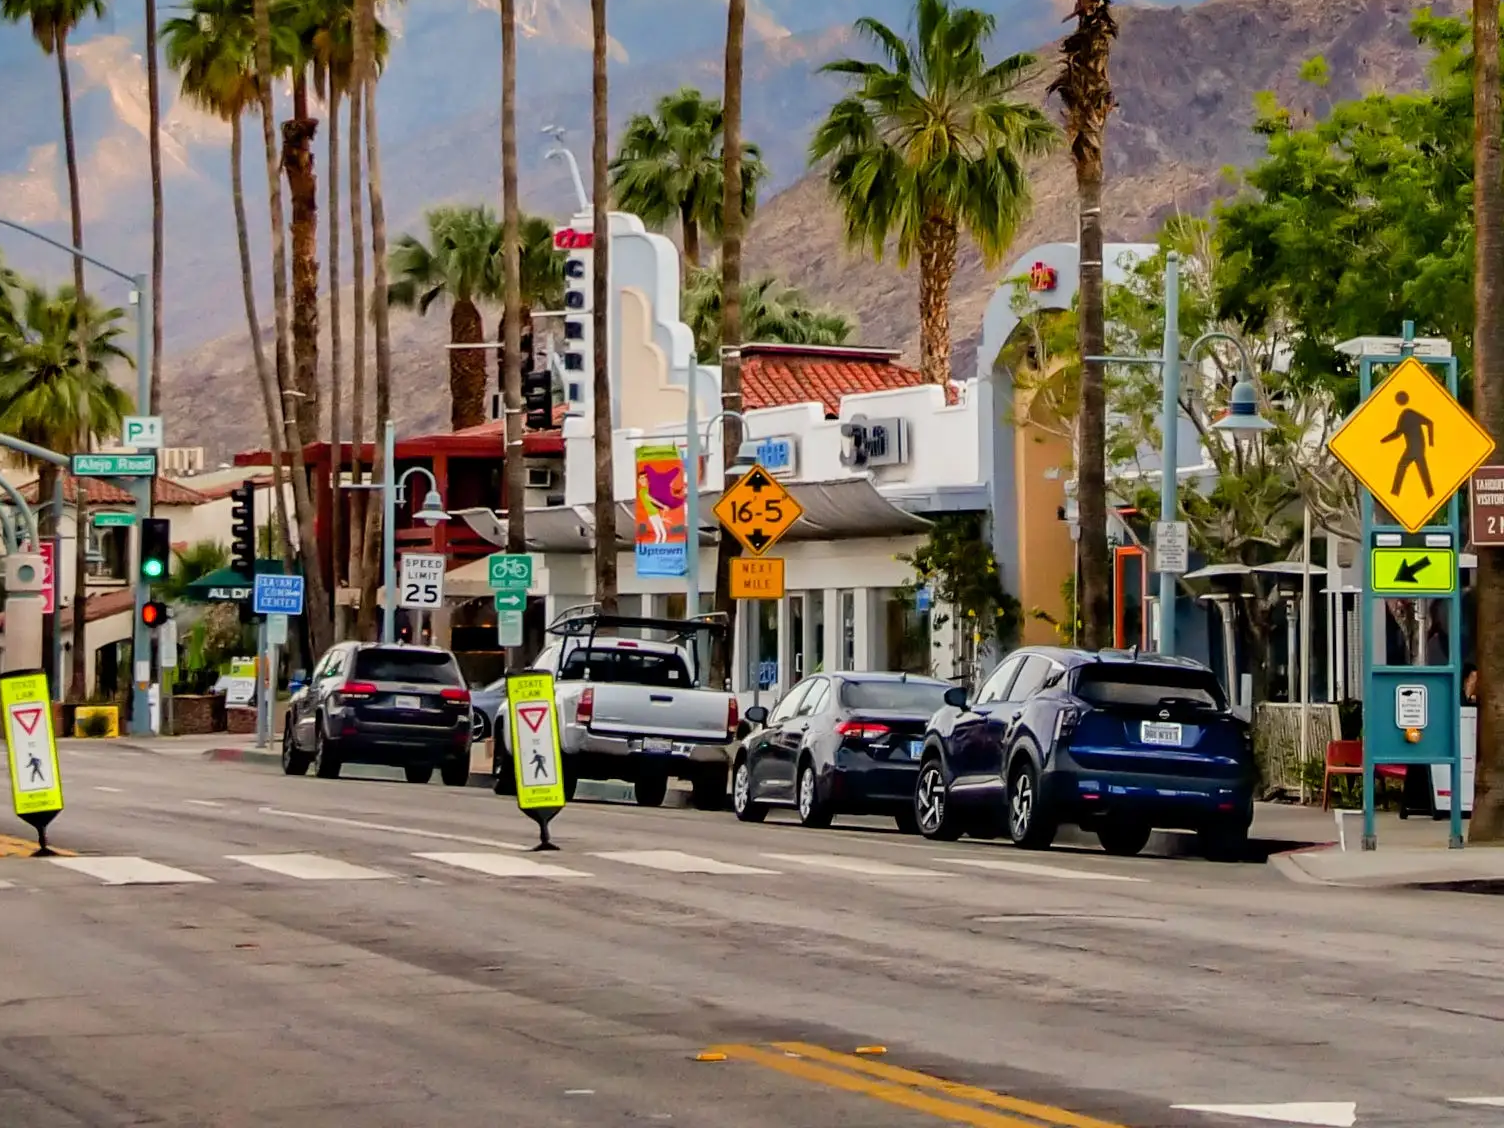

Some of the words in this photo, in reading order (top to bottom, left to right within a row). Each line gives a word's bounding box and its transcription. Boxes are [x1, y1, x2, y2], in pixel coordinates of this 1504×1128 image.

[564, 260, 584, 417] CORRI
[129, 422, 143, 442] P
[78, 459, 112, 472] Alejo
[118, 458, 152, 470] Road
[1487, 516, 1496, 534] 2
[638, 543, 684, 557] Uptown
[405, 559, 442, 569] SPEED
[742, 563, 772, 573] NEXT
[408, 572, 438, 581] LIMIT
[743, 579, 771, 589] MILE
[405, 583, 438, 603] 25
